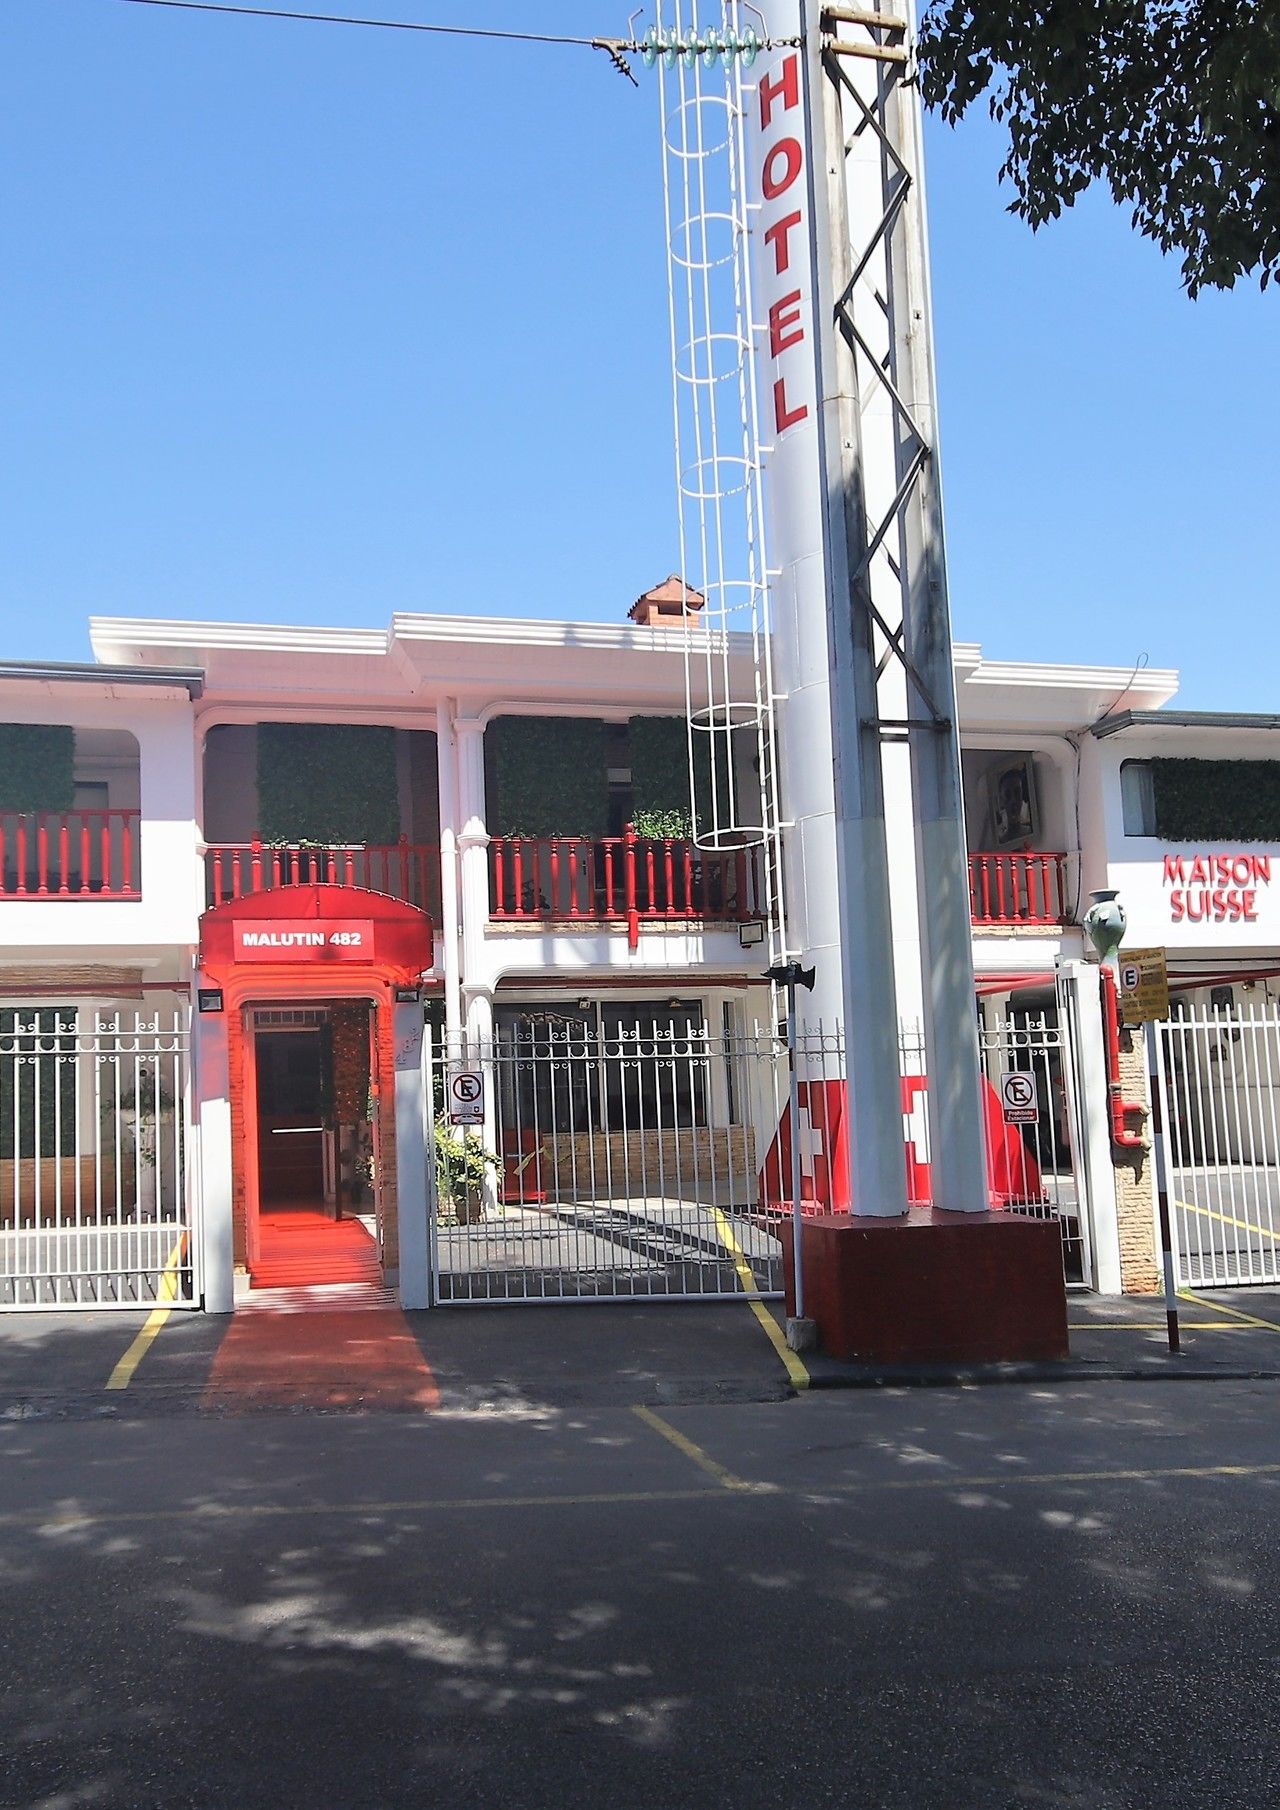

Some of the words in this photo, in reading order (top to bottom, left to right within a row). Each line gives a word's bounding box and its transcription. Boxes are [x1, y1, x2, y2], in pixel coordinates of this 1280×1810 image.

[759, 53, 808, 435] HOTEL
[1163, 852, 1271, 887] MAISON
[1170, 889, 1259, 921] SUISSE
[242, 932, 325, 946] MALUTIN
[329, 932, 362, 946] 482
[1125, 969, 1136, 986] E
[460, 1079, 473, 1097] E
[1012, 1081, 1027, 1102] E
